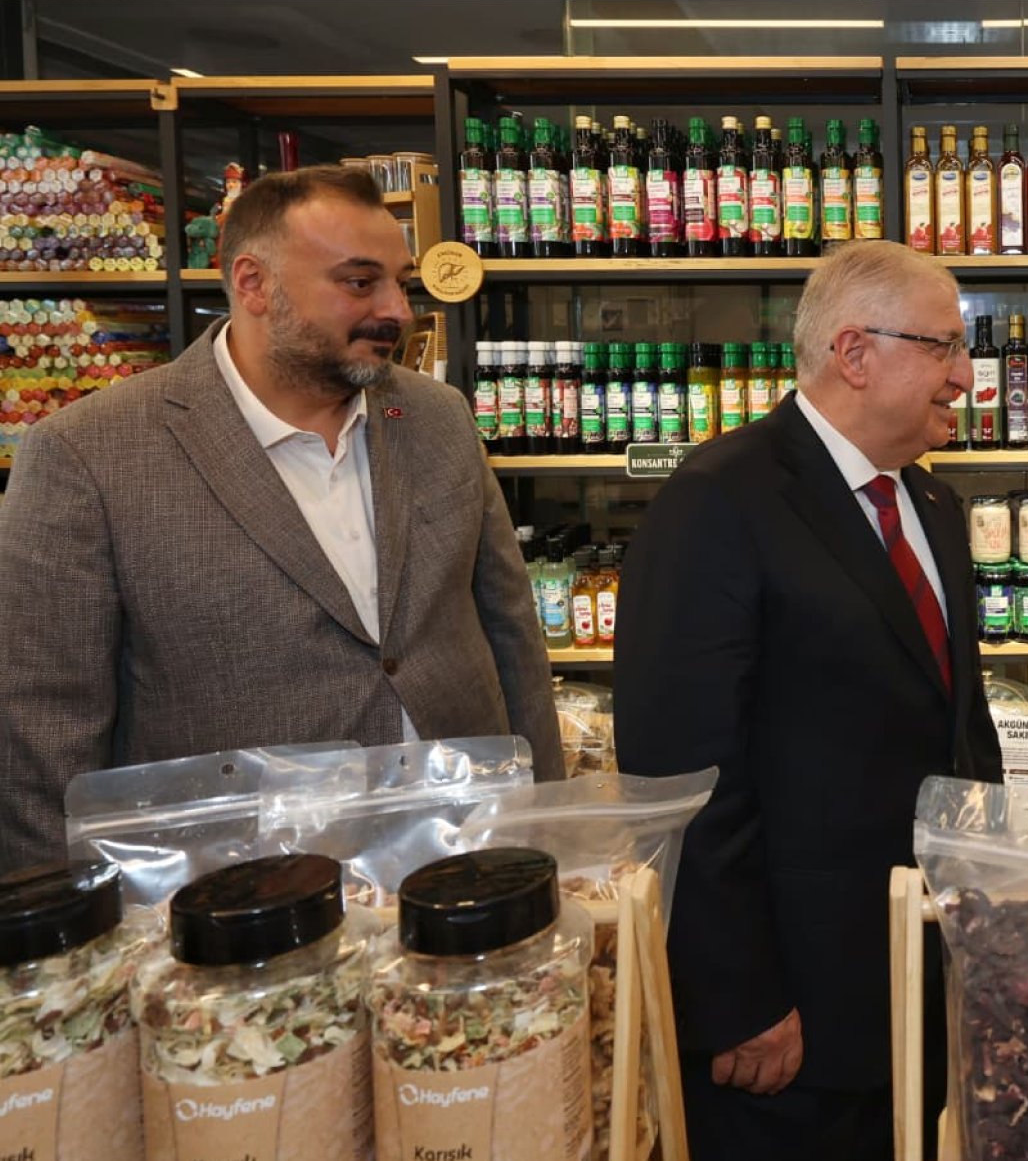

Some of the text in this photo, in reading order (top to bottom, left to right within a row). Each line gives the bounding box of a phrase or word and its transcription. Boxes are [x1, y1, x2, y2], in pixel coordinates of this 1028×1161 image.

[631, 458, 678, 469] KONSANTRE
[0, 1088, 54, 1116] yfene
[199, 1095, 277, 1120] Hayfene
[419, 1086, 490, 1108] Hayfene
